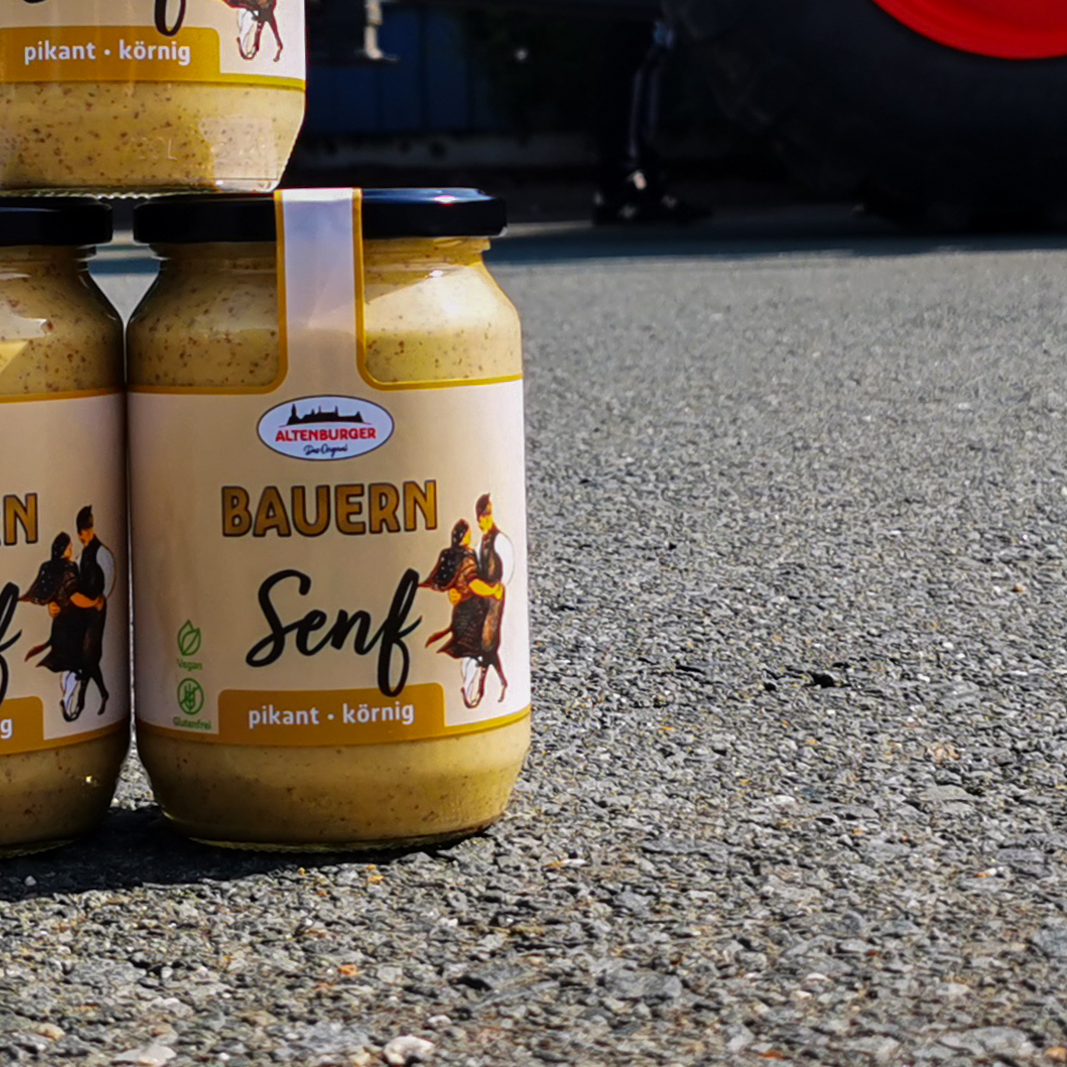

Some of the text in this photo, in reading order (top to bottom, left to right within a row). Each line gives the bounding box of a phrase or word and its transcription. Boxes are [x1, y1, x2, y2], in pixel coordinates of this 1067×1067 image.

[24, 39, 191, 66] pikant körnig
[275, 426, 376, 442] ALTENBURGER
[221, 479, 437, 538] BAUERN
[245, 567, 422, 697] Senf
[177, 658, 203, 671] Vegan
[172, 715, 212, 731] Glutenfrei
[248, 701, 415, 729] pikant körnig
